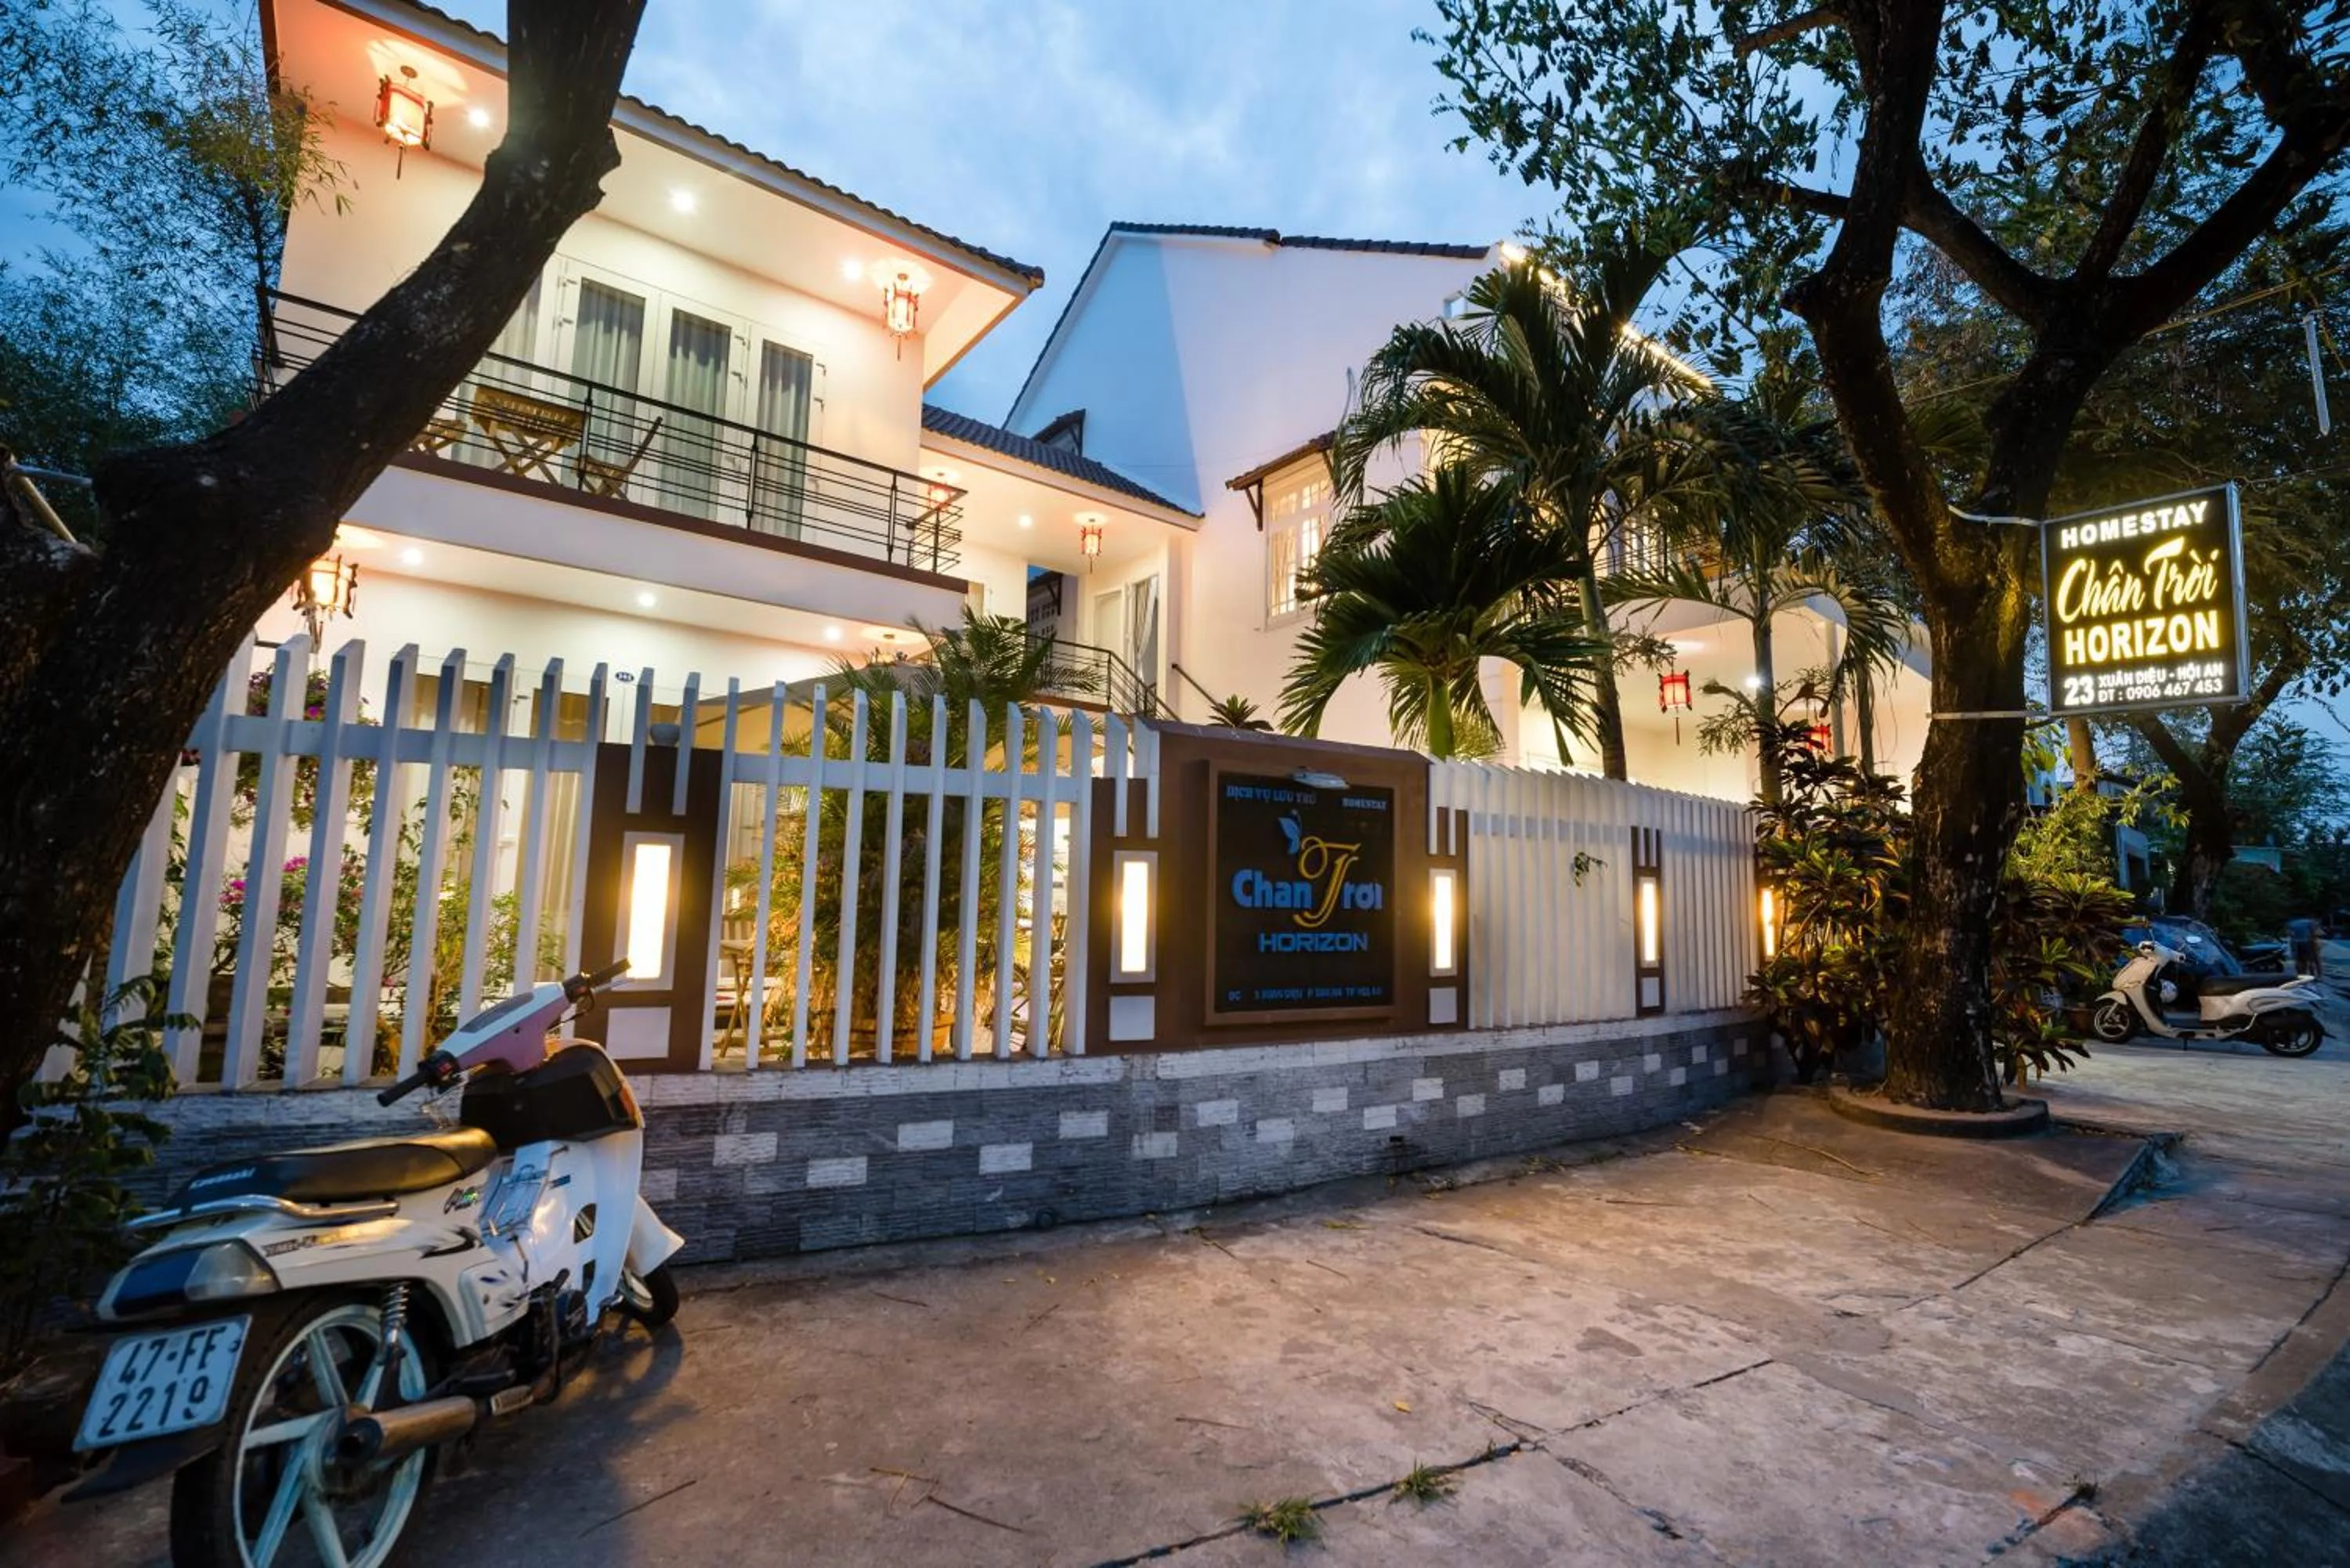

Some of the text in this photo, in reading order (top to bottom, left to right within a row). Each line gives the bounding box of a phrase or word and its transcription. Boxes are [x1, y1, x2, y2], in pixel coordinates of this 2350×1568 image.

[2059, 500, 2207, 549] HOMESTAY
[2056, 536, 2218, 623] Chân Trời
[2063, 609, 2219, 665] HORIZON
[2063, 674, 2095, 706] 23
[2098, 670, 2134, 688] XUÂN
[2135, 667, 2167, 685] DIỆU
[2177, 662, 2200, 682] HỘI
[2203, 662, 2223, 677] AN
[2126, 685, 2161, 700] 0906
[2164, 681, 2191, 696] 467
[2194, 678, 2223, 694] 453
[1258, 931, 1369, 953] HORIZON
[97, 1375, 209, 1438] 2219
